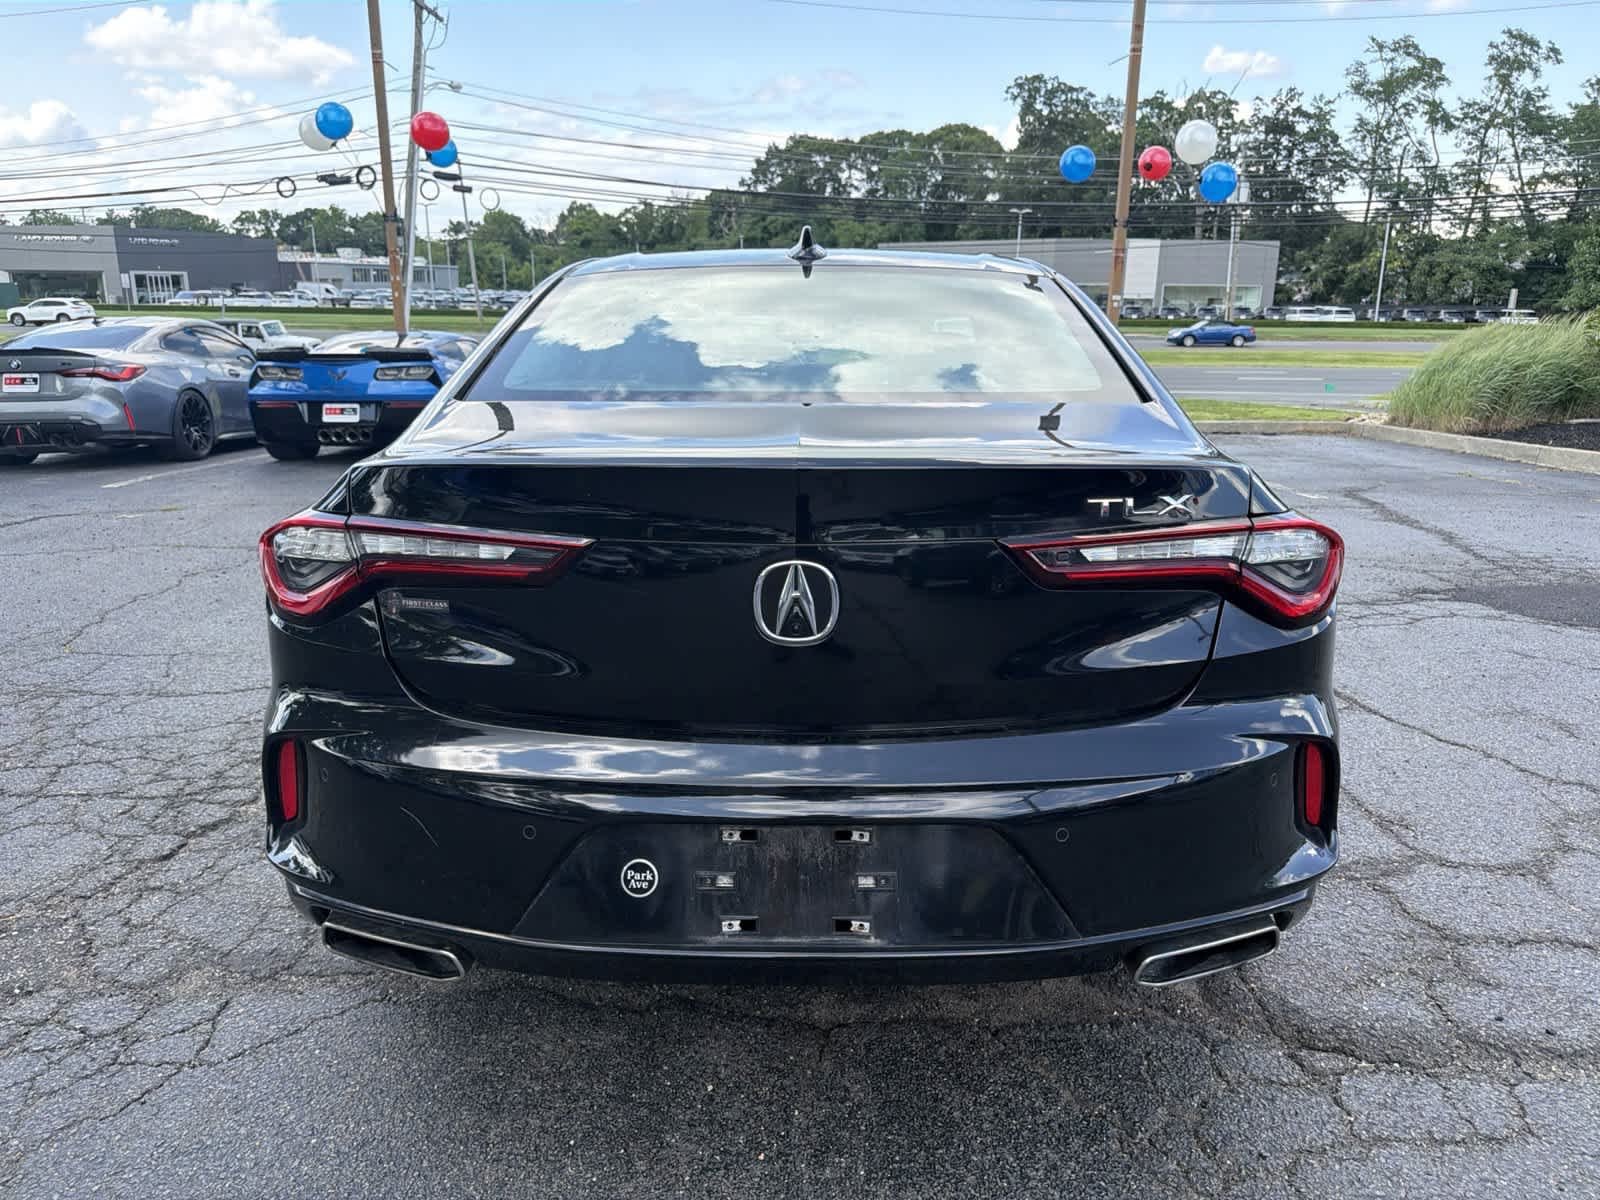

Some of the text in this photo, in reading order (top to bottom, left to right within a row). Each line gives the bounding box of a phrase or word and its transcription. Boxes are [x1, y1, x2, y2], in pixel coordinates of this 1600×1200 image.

[1087, 494, 1193, 518] TLX
[627, 870, 653, 880] Park
[628, 879, 649, 888] Ave
